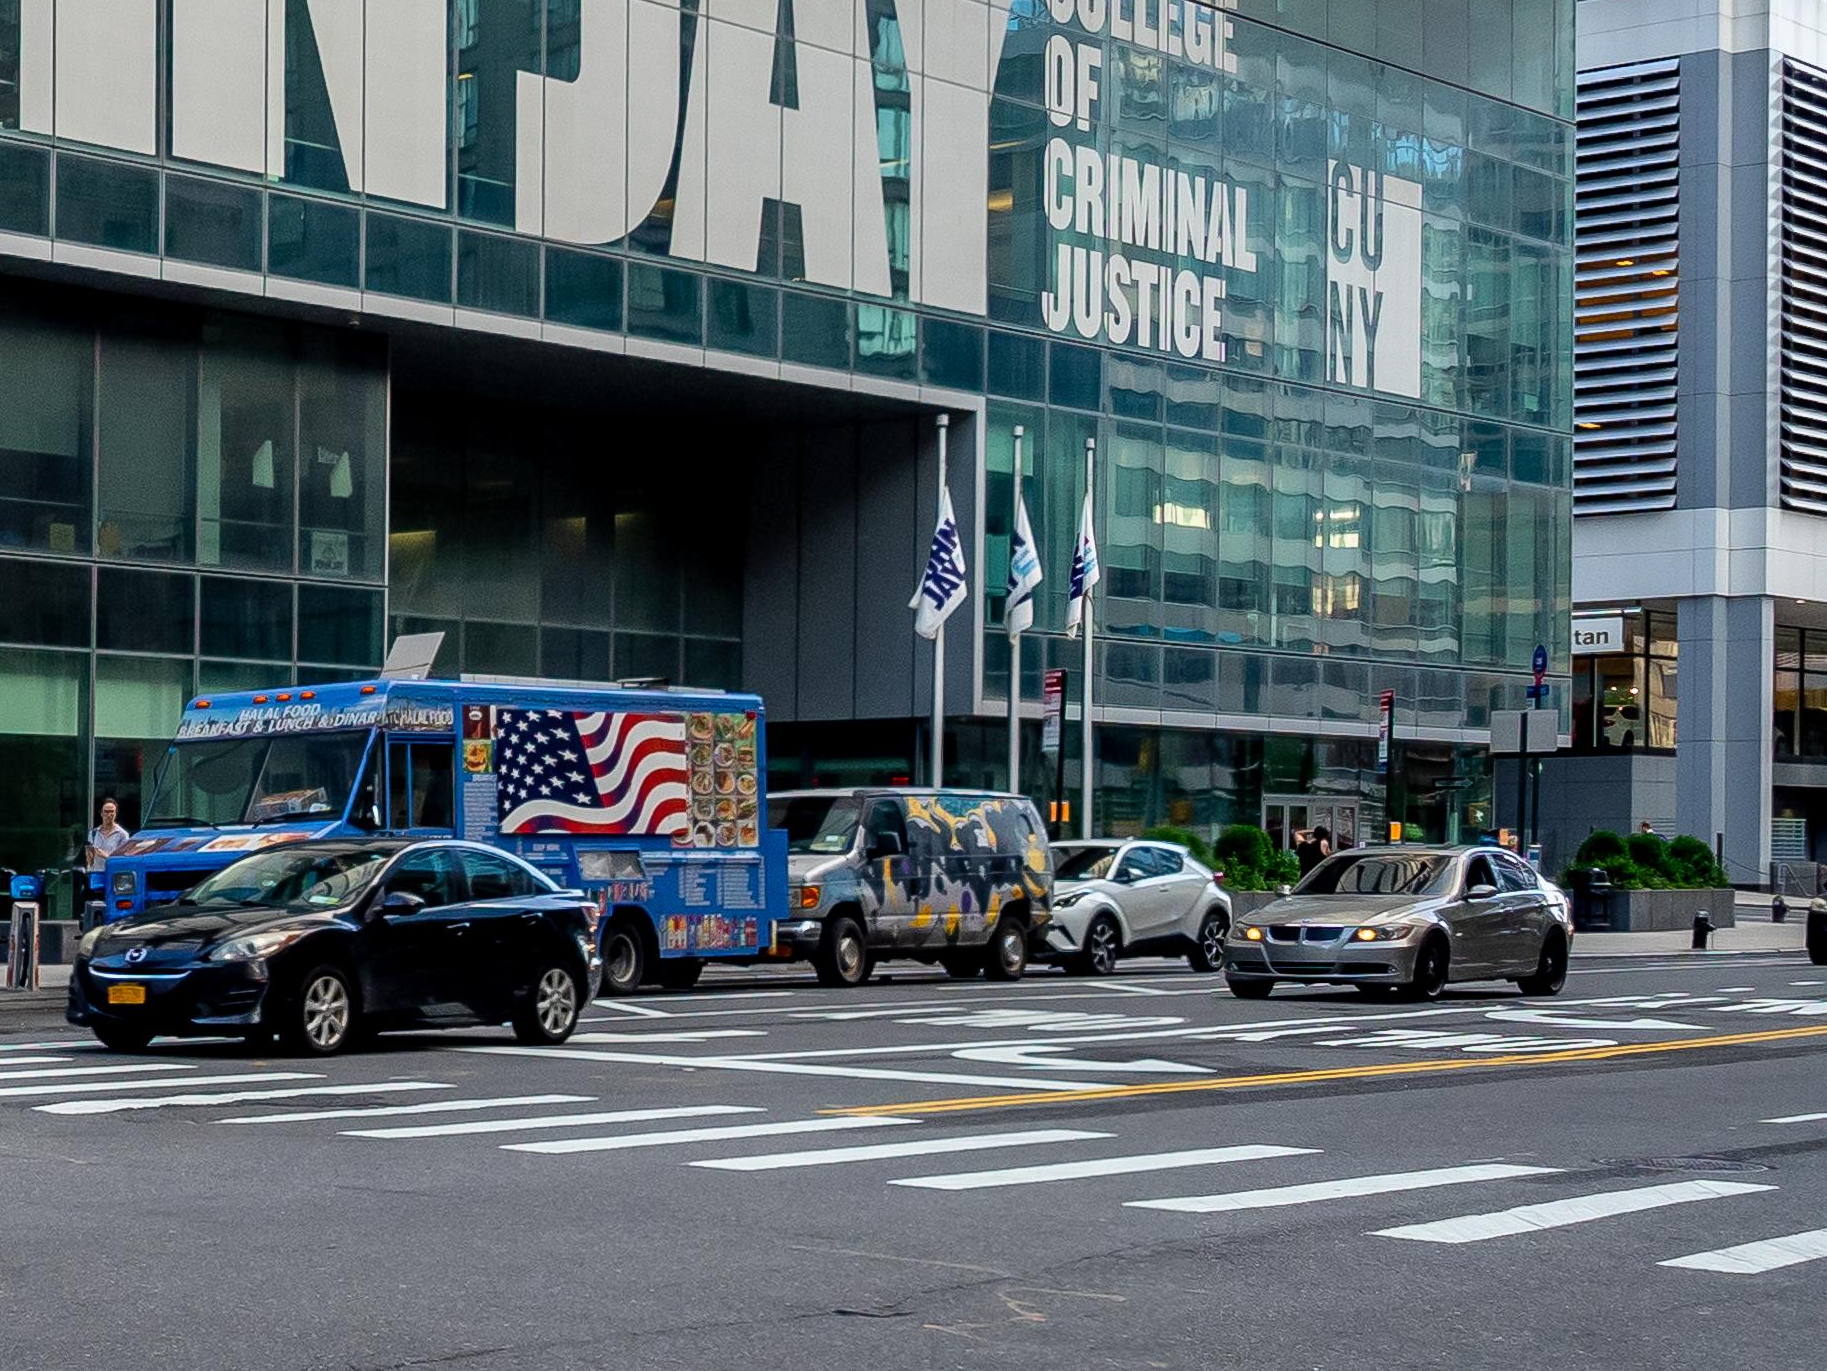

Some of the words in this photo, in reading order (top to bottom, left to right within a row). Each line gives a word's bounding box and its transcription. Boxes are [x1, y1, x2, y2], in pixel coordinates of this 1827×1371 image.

[1044, 34, 1102, 131] OF
[1043, 137, 1257, 272] CRIMINAL
[1041, 242, 1227, 363] JUSTICE
[1574, 630, 1609, 646] tan
[177, 718, 251, 739] BREAKFAST
[253, 720, 263, 733] &
[268, 717, 313, 732] LUNCH
[239, 708, 281, 722] HALAL
[283, 703, 321, 719] FOOD
